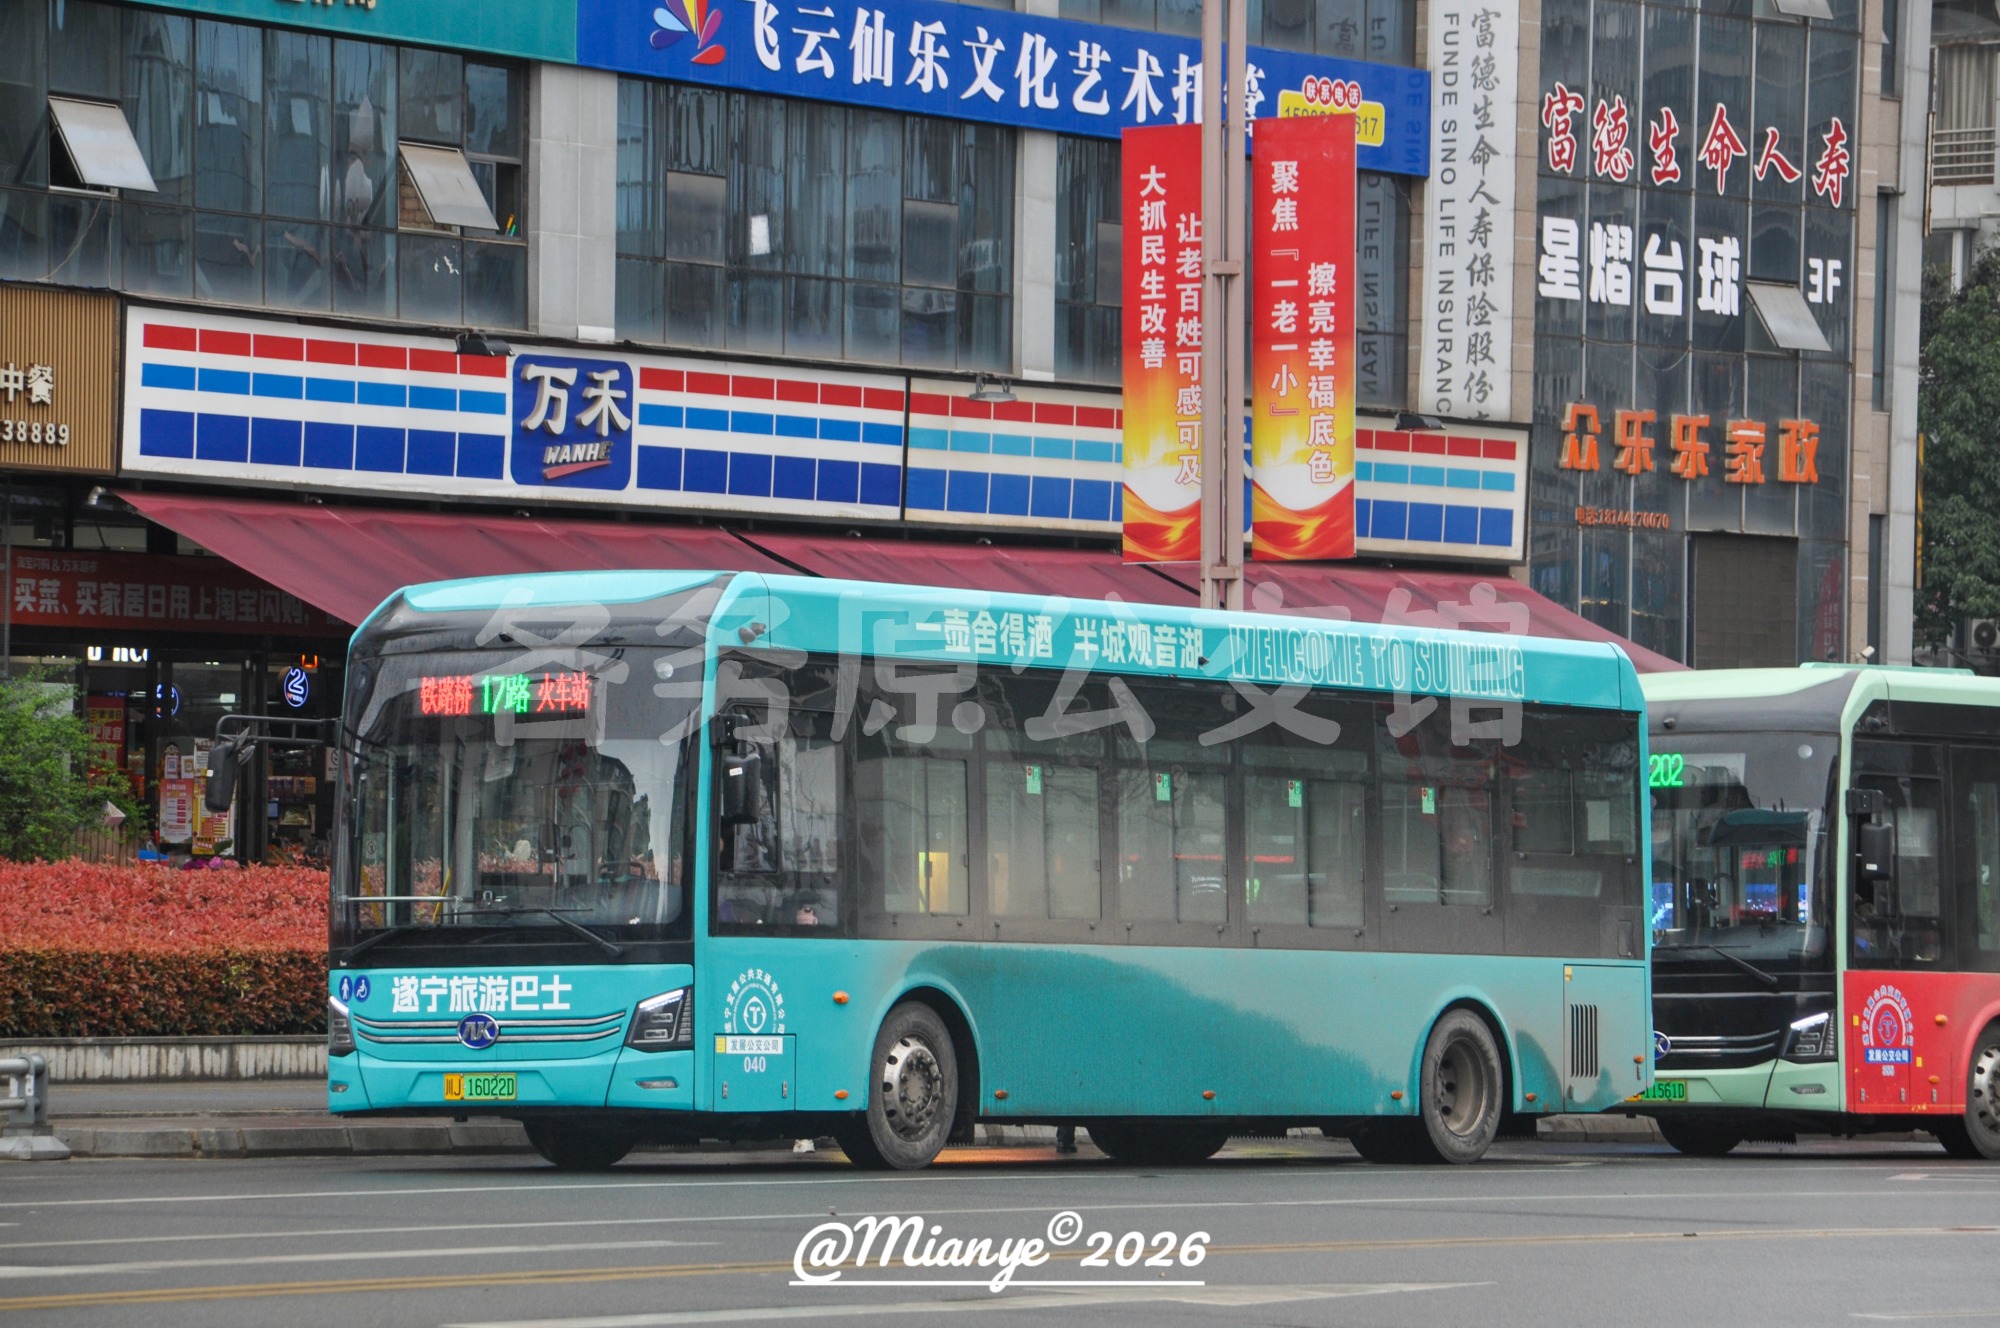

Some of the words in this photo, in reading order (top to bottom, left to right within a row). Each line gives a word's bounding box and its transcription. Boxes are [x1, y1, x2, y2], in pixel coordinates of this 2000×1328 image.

[1442, 13, 1459, 106] FUNDE
[1306, 81, 1359, 108] 联系电话
[1440, 119, 1457, 185] SINO
[1542, 81, 1850, 208] 富德生命人寿
[1439, 198, 1456, 257] LIFE
[1139, 165, 1167, 369] 大抓民生改善
[1807, 257, 1842, 304] 3F
[1175, 212, 1202, 485] 让老百姓可感可及
[1307, 261, 1335, 484] 擦亮幸福底色
[520, 363, 632, 437] 万禾
[2, 419, 70, 445] 38889
[543, 442, 614, 464] WANHE
[1559, 401, 1820, 484] 众乐乐家政
[915, 608, 1053, 659] 一壶舍得酒
[1074, 617, 1203, 670] 半城观音湖
[1229, 623, 1364, 688] WELCOME
[1370, 635, 1405, 690] TO
[1414, 637, 1525, 698] SUINING
[481, 672, 531, 714] 17路
[537, 672, 591, 714] 火车站
[1649, 753, 1684, 787] 202
[391, 974, 572, 1014] 遂宁旅游巴士
[730, 1039, 779, 1052] 发展公交公司
[744, 1056, 767, 1073] 040
